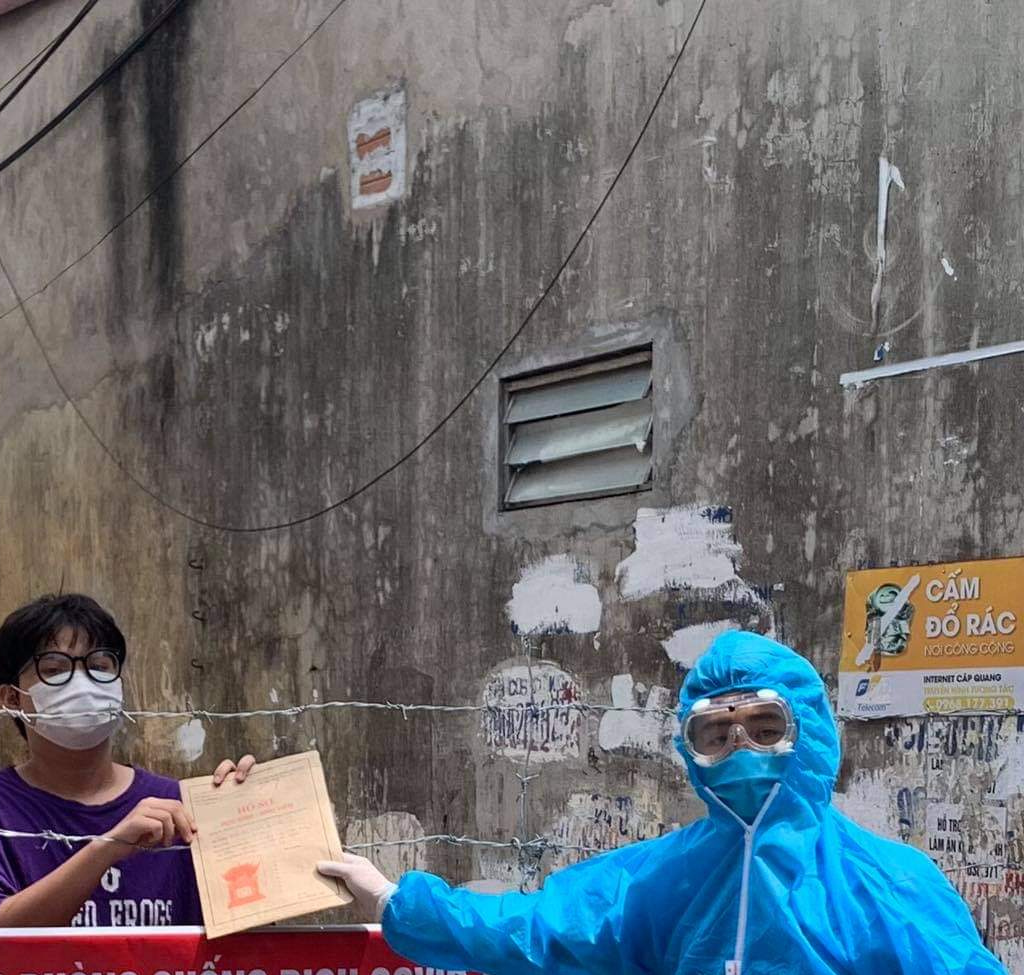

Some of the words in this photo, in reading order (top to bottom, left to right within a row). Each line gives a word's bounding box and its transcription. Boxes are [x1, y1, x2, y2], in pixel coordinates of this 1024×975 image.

[925, 568, 980, 602] CẤM
[925, 602, 961, 638] ĐỔ
[966, 606, 1016, 636] RÁC
[923, 674, 955, 684] INTERNET
[956, 673, 972, 683] CÁP
[973, 674, 1002, 682] QUANG
